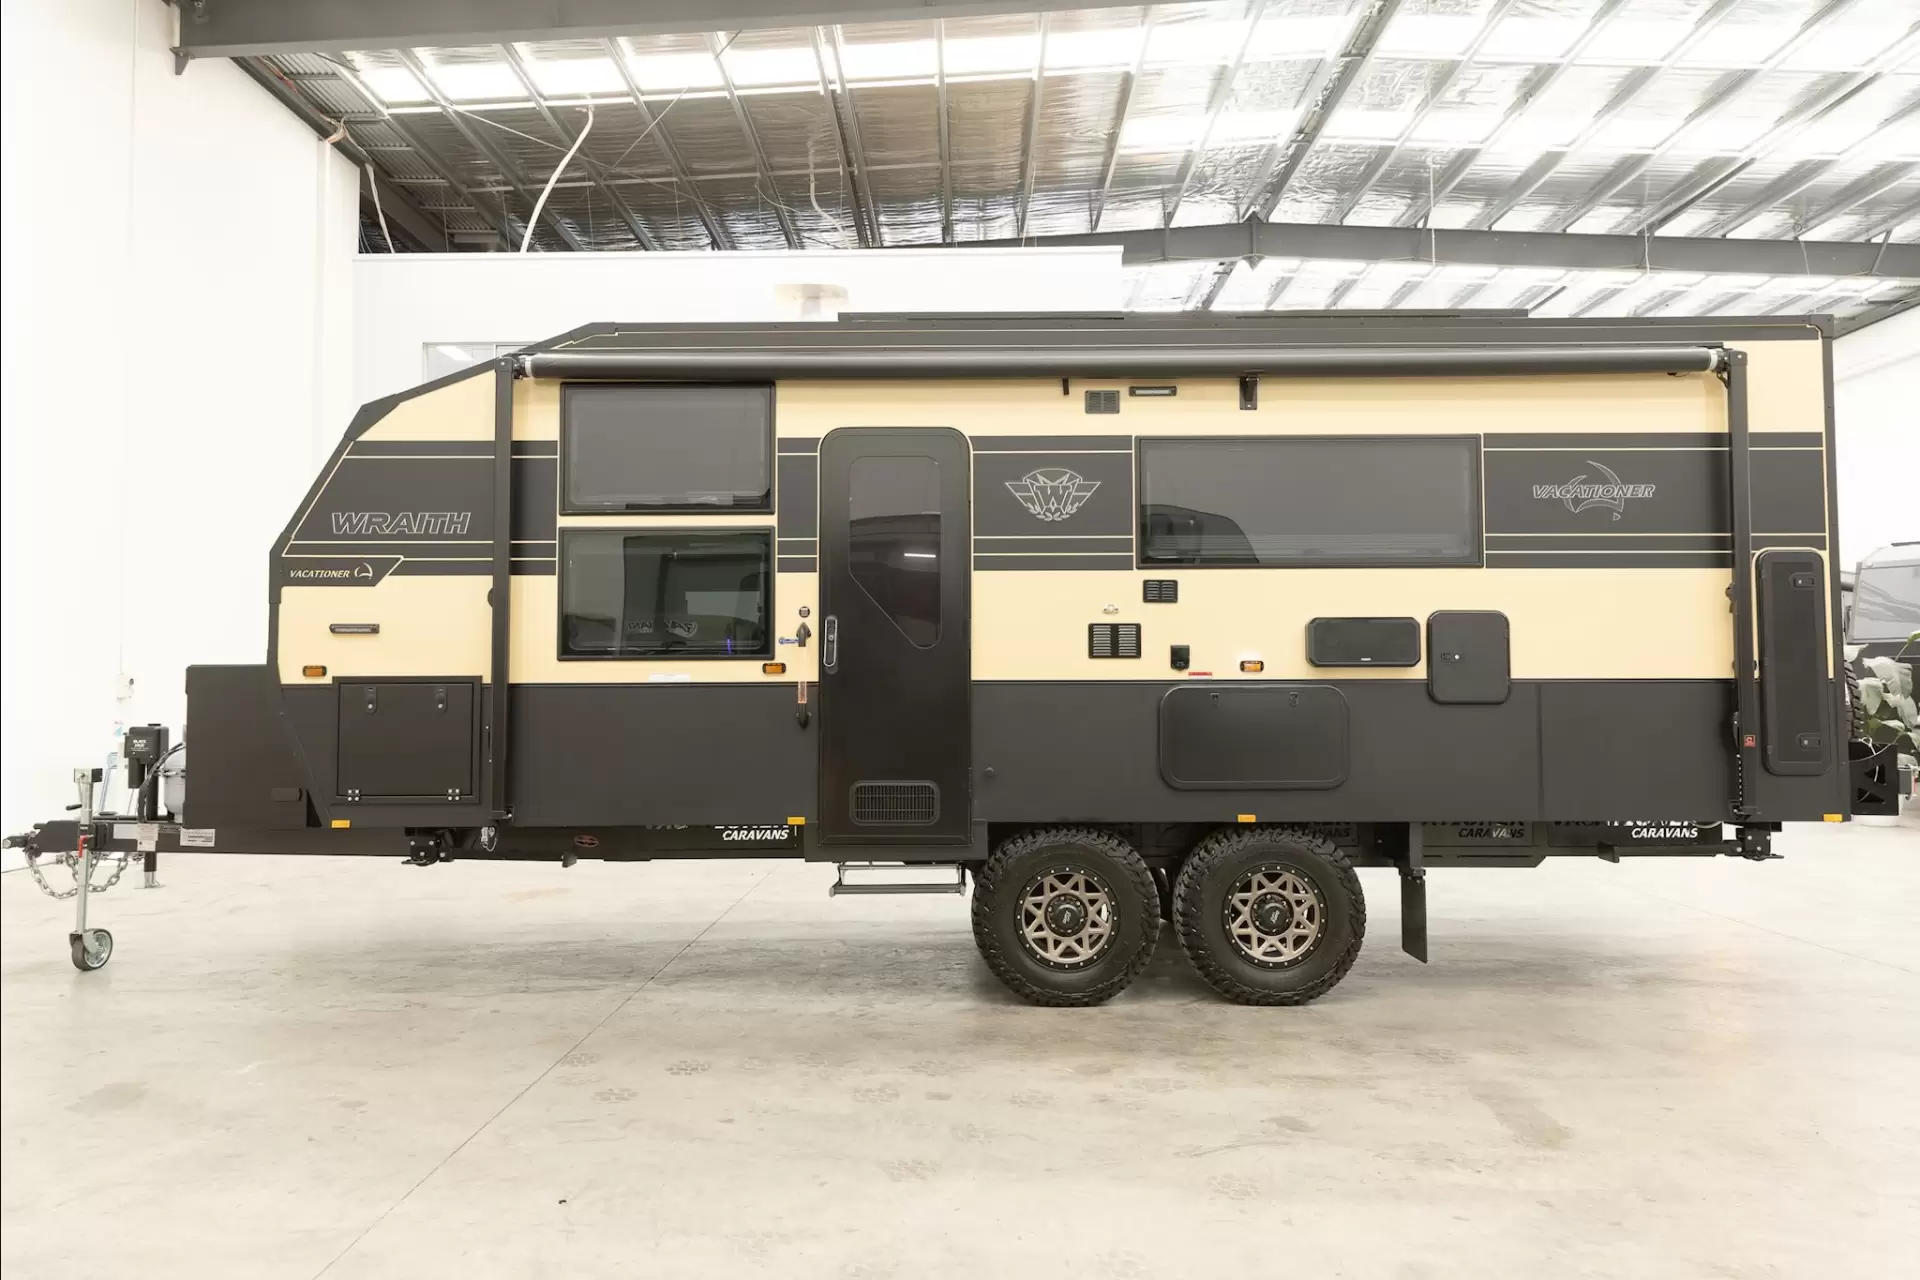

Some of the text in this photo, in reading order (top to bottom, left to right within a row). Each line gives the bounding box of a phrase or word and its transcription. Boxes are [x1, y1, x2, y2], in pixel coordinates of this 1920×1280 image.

[1532, 484, 1656, 499] VACATIONER
[331, 511, 472, 535] WRAITH
[289, 569, 351, 578] VACATIONER
[722, 829, 790, 841] CARAVANS
[1631, 827, 1699, 839] CARAVANS
